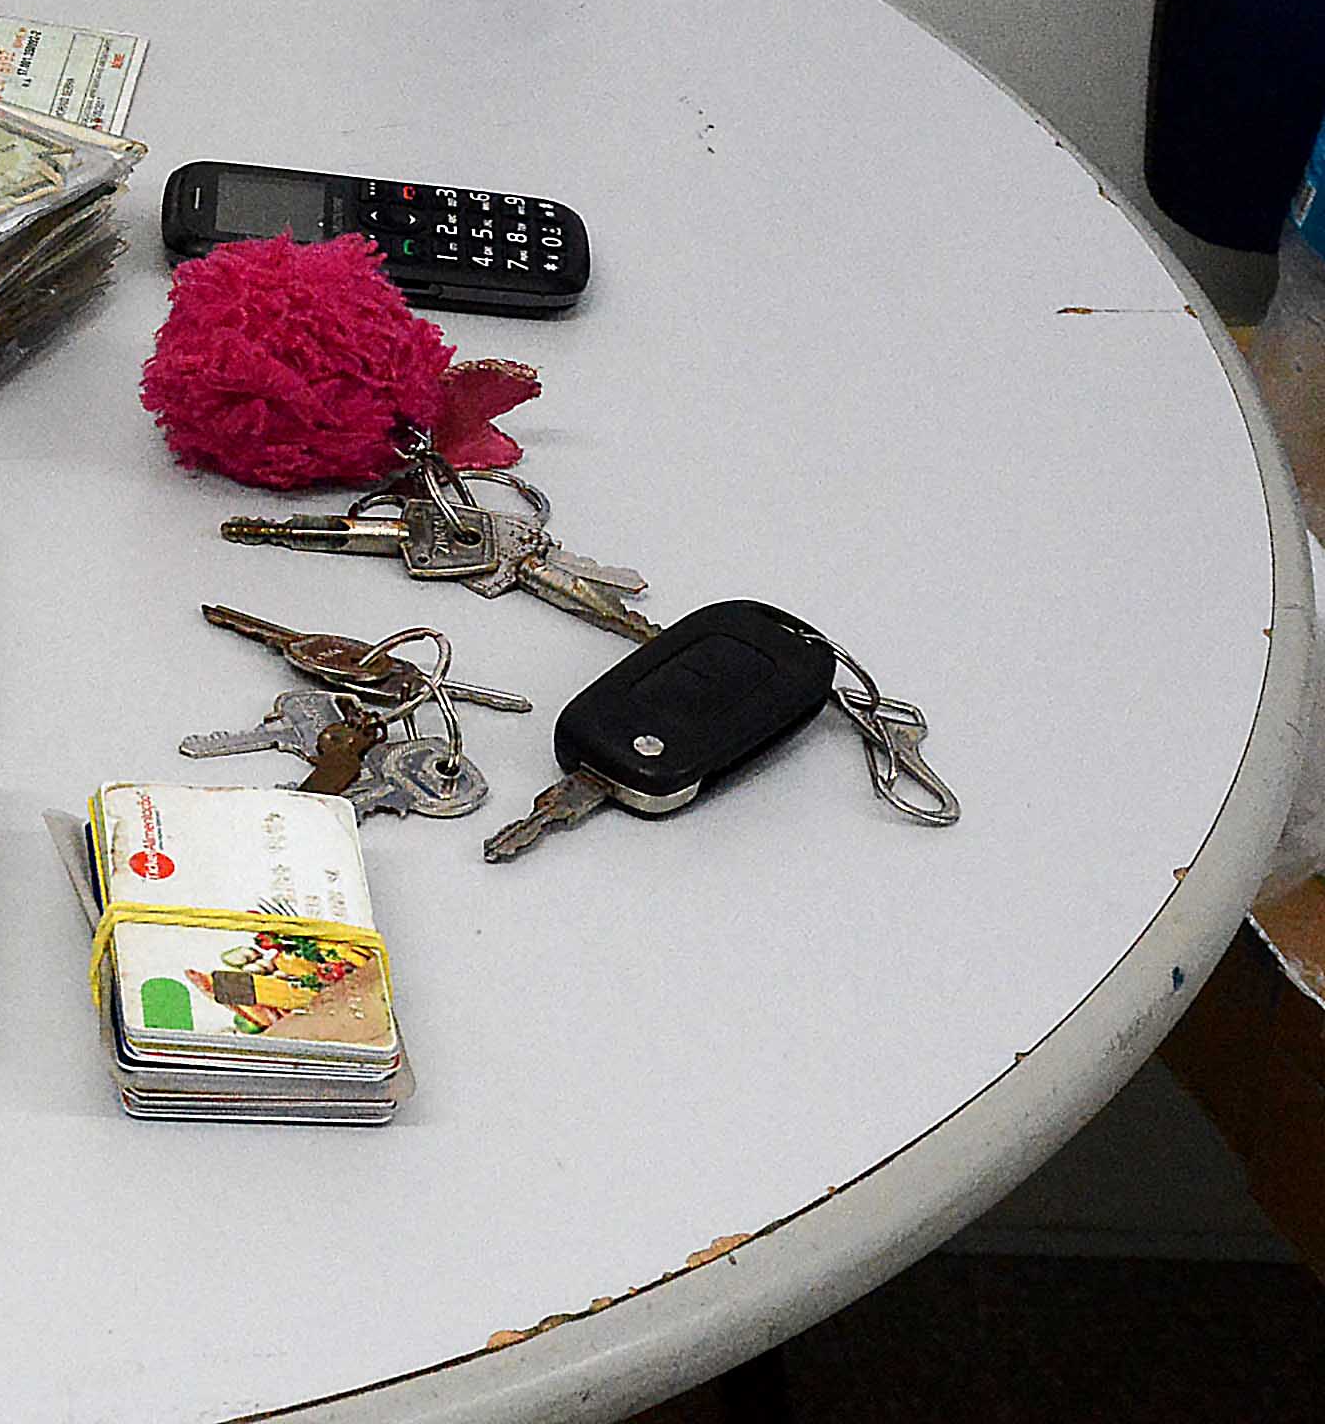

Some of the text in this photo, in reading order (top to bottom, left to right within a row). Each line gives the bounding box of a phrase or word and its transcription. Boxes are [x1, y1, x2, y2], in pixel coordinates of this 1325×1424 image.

[436, 189, 456, 197] 3
[470, 193, 489, 201] 6
[504, 197, 525, 205] 9
[437, 224, 457, 234] 2
[472, 229, 493, 239] 5
[506, 233, 527, 243] 8
[542, 237, 562, 247] 0
[472, 257, 493, 266] 4
[507, 259, 529, 270] 7
